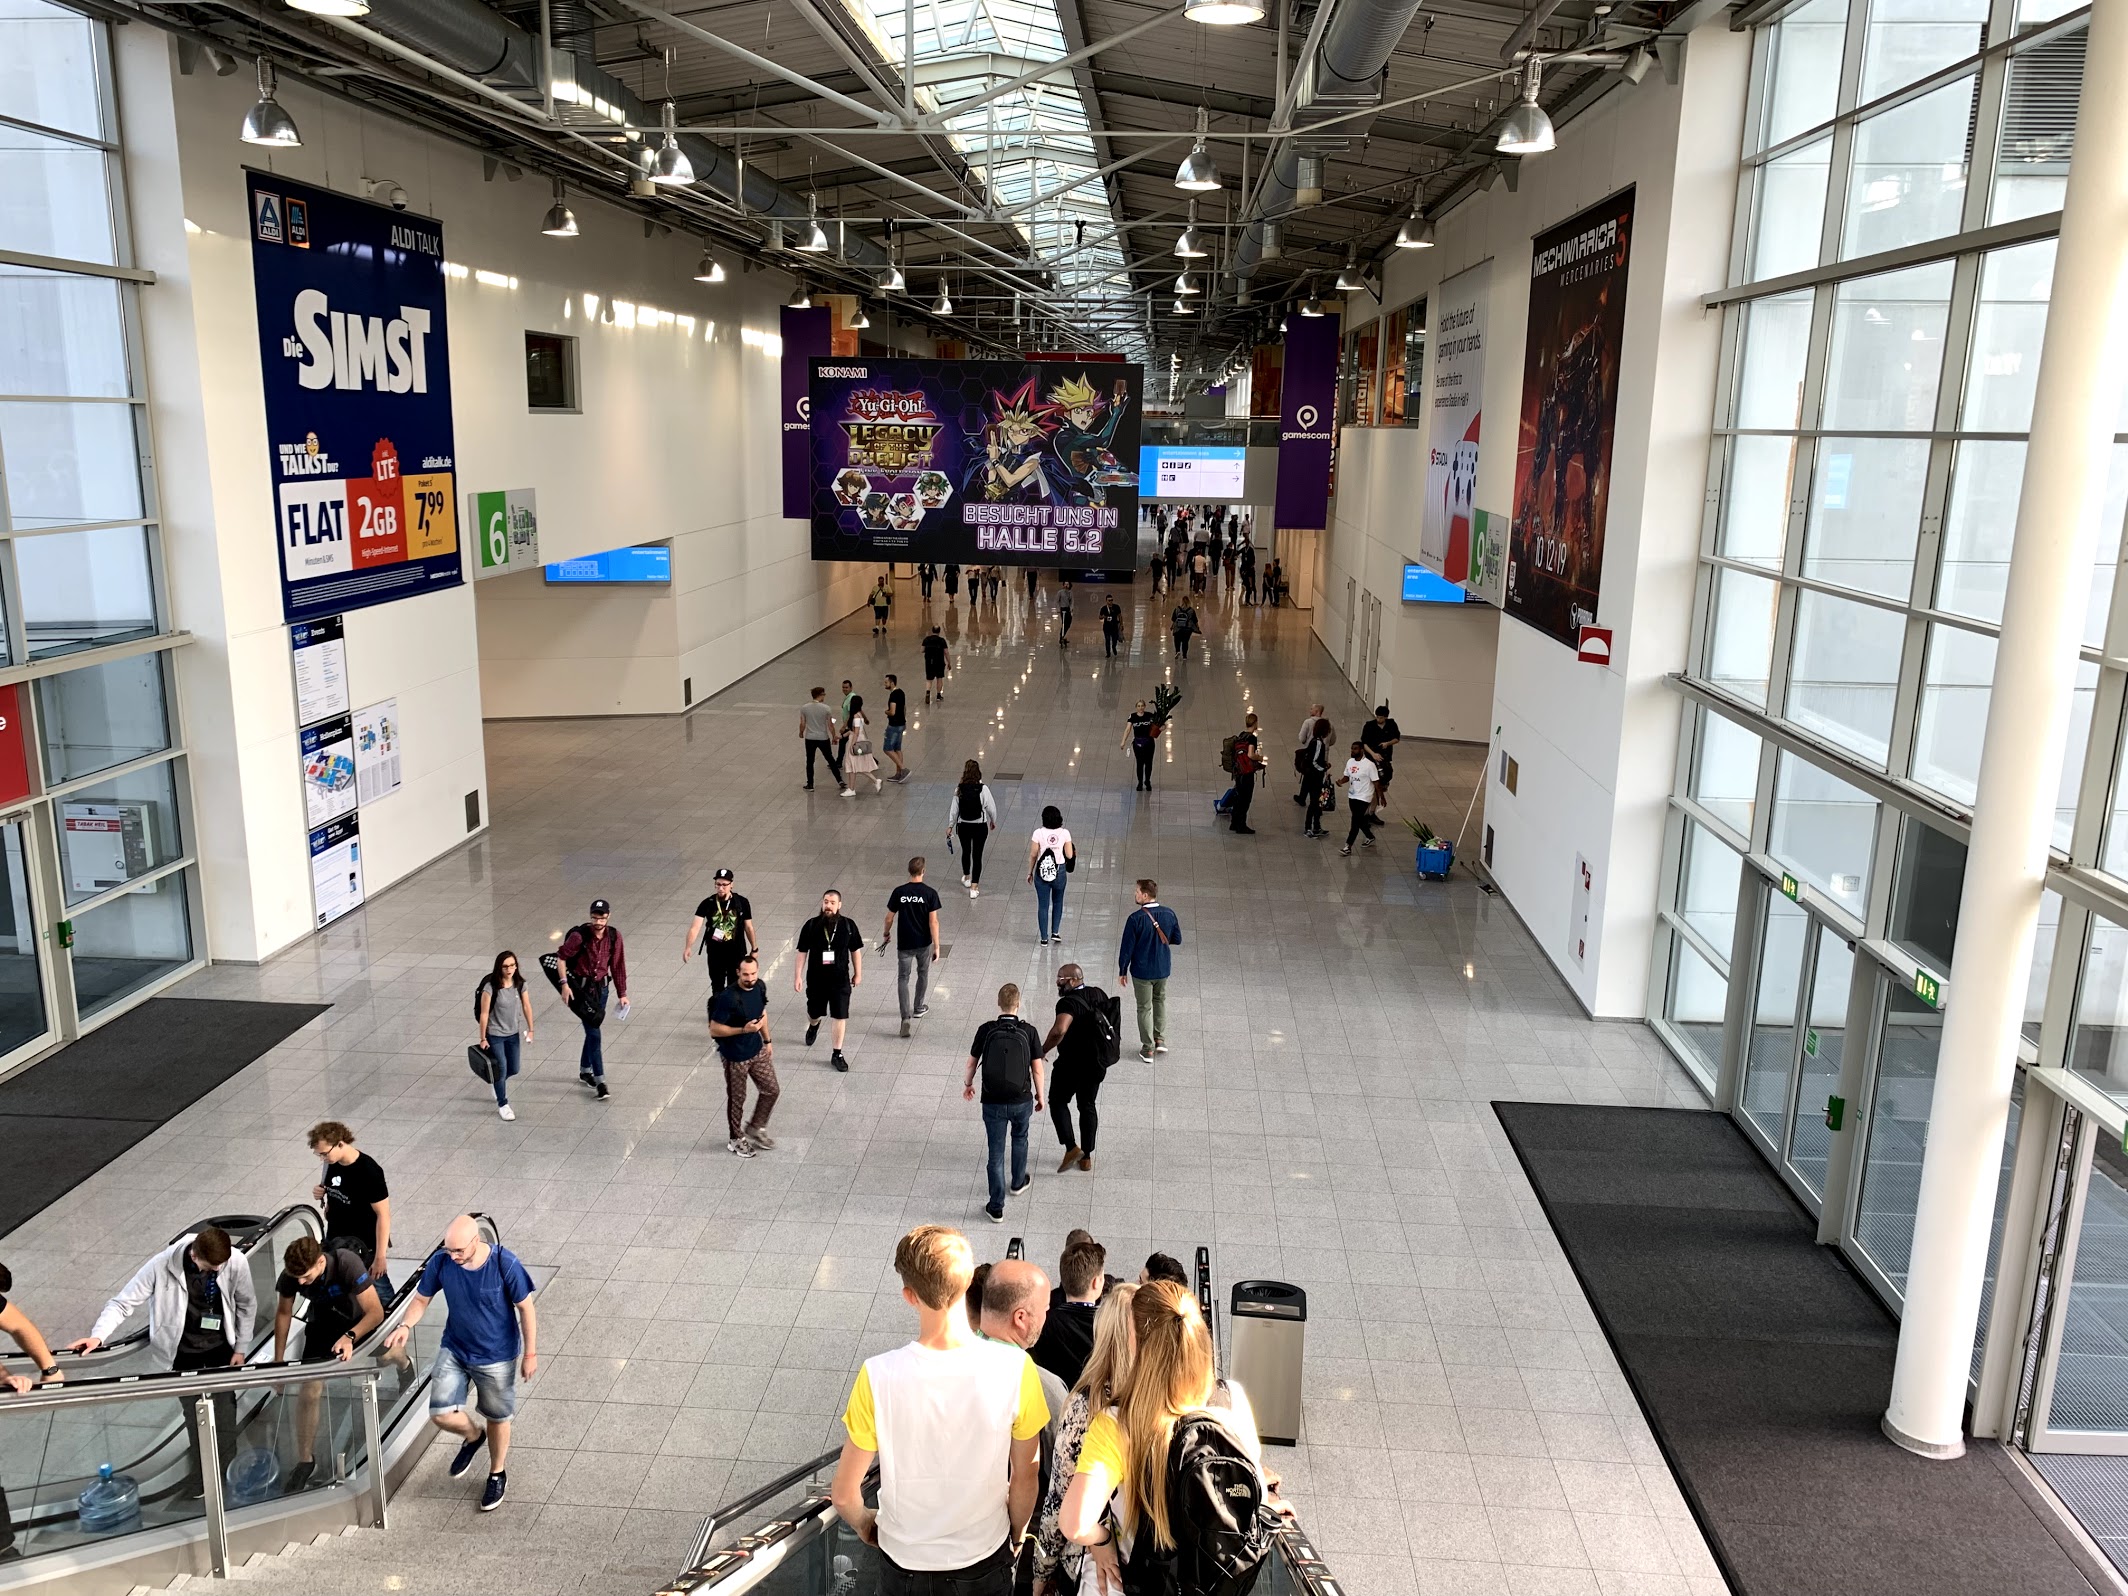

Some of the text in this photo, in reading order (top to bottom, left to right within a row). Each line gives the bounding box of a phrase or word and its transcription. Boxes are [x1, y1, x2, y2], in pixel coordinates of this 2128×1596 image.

[262, 226, 279, 237] ALDI
[292, 226, 306, 236] ALDI
[391, 225, 440, 256] ALDI TALK
[1533, 213, 1628, 278] MECHWARRIOR 5
[1560, 254, 1614, 287] MERCENARIES
[283, 289, 430, 394] Die SIMST
[818, 367, 867, 378] KONAMI
[860, 399, 922, 413] Yu-Gi-Oh!
[279, 444, 306, 454] UND WIE
[849, 424, 934, 450] LEGACY
[1282, 432, 1330, 440] gamescom
[280, 454, 339, 476] TALKST DU?
[422, 456, 452, 469] alditalk.de
[849, 451, 933, 468] DUELIST
[1436, 452, 1448, 466] STADIA
[288, 500, 344, 547] FLAT
[357, 496, 397, 538] 2GB
[415, 491, 444, 537] 7,99
[964, 504, 1118, 528] BESUCHT UNS IN
[490, 511, 506, 565] 6
[978, 526, 1102, 552] HALLE 5.2
[1475, 532, 1485, 584] 9
[1535, 536, 1567, 576] 10 12 19
